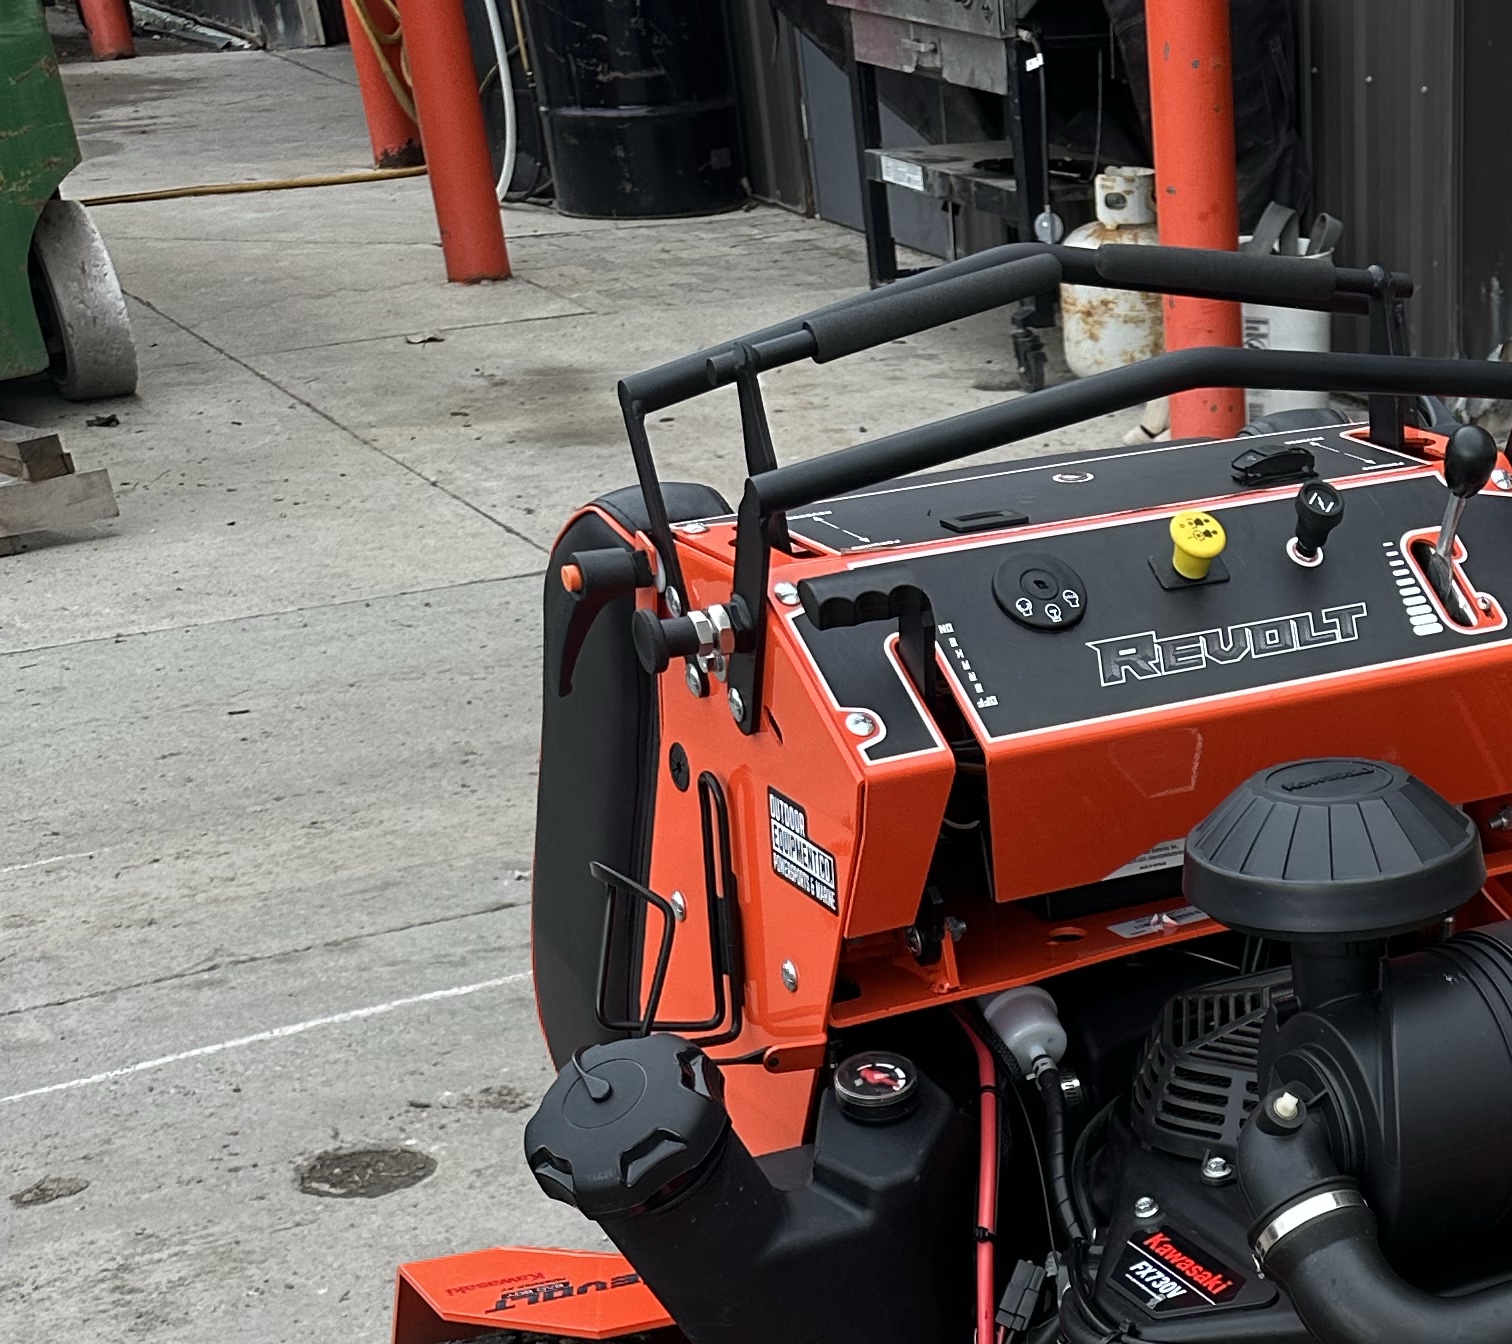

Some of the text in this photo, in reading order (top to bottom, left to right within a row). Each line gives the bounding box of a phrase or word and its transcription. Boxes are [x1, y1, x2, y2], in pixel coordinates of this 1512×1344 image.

[1085, 601, 1368, 687] REVOLT
[772, 823, 820, 876] EQUIPMENT
[446, 1271, 546, 1297] Kawasaki
[1128, 1259, 1188, 1299] FX730V
[1142, 1231, 1234, 1296] Kawasaki
[485, 1273, 647, 1315] EVOLT
